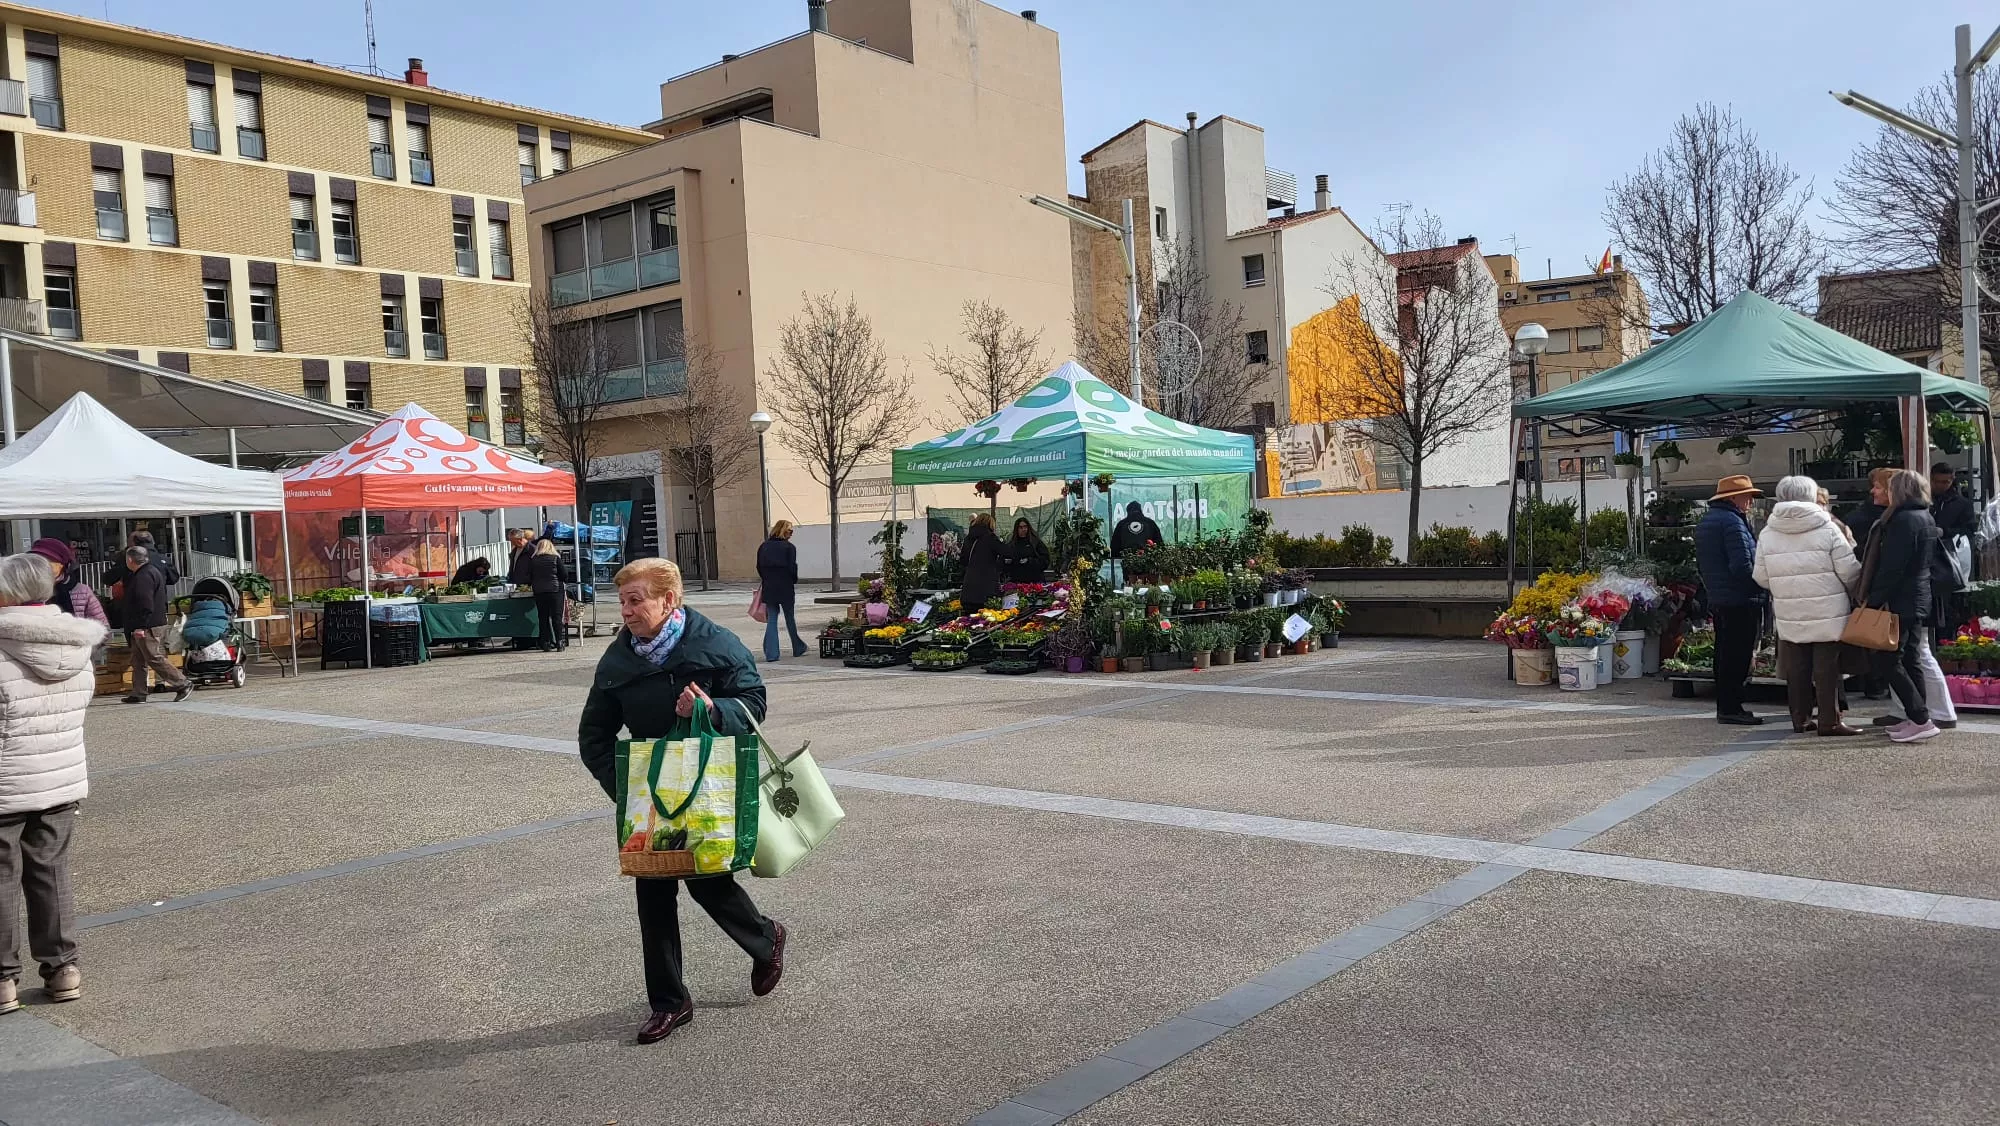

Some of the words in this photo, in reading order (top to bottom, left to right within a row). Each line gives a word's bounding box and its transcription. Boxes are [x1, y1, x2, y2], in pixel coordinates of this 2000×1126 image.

[1103, 448, 1113, 457] El
[1116, 448, 1140, 460] mejor
[1142, 448, 1171, 459] garden
[1172, 448, 1184, 457] del
[1186, 448, 1212, 457] mundo
[1213, 448, 1244, 457] mundial
[907, 462, 916, 471] El
[917, 461, 941, 472] mejor
[942, 459, 972, 471] garden
[973, 458, 986, 467] del
[988, 455, 1022, 466] mundo
[1023, 450, 1067, 463] mundial
[424, 483, 482, 493] Cultivamos
[484, 484, 495, 492] tu
[497, 484, 524, 492] salud
[882, 485, 908, 495] VICNTE
